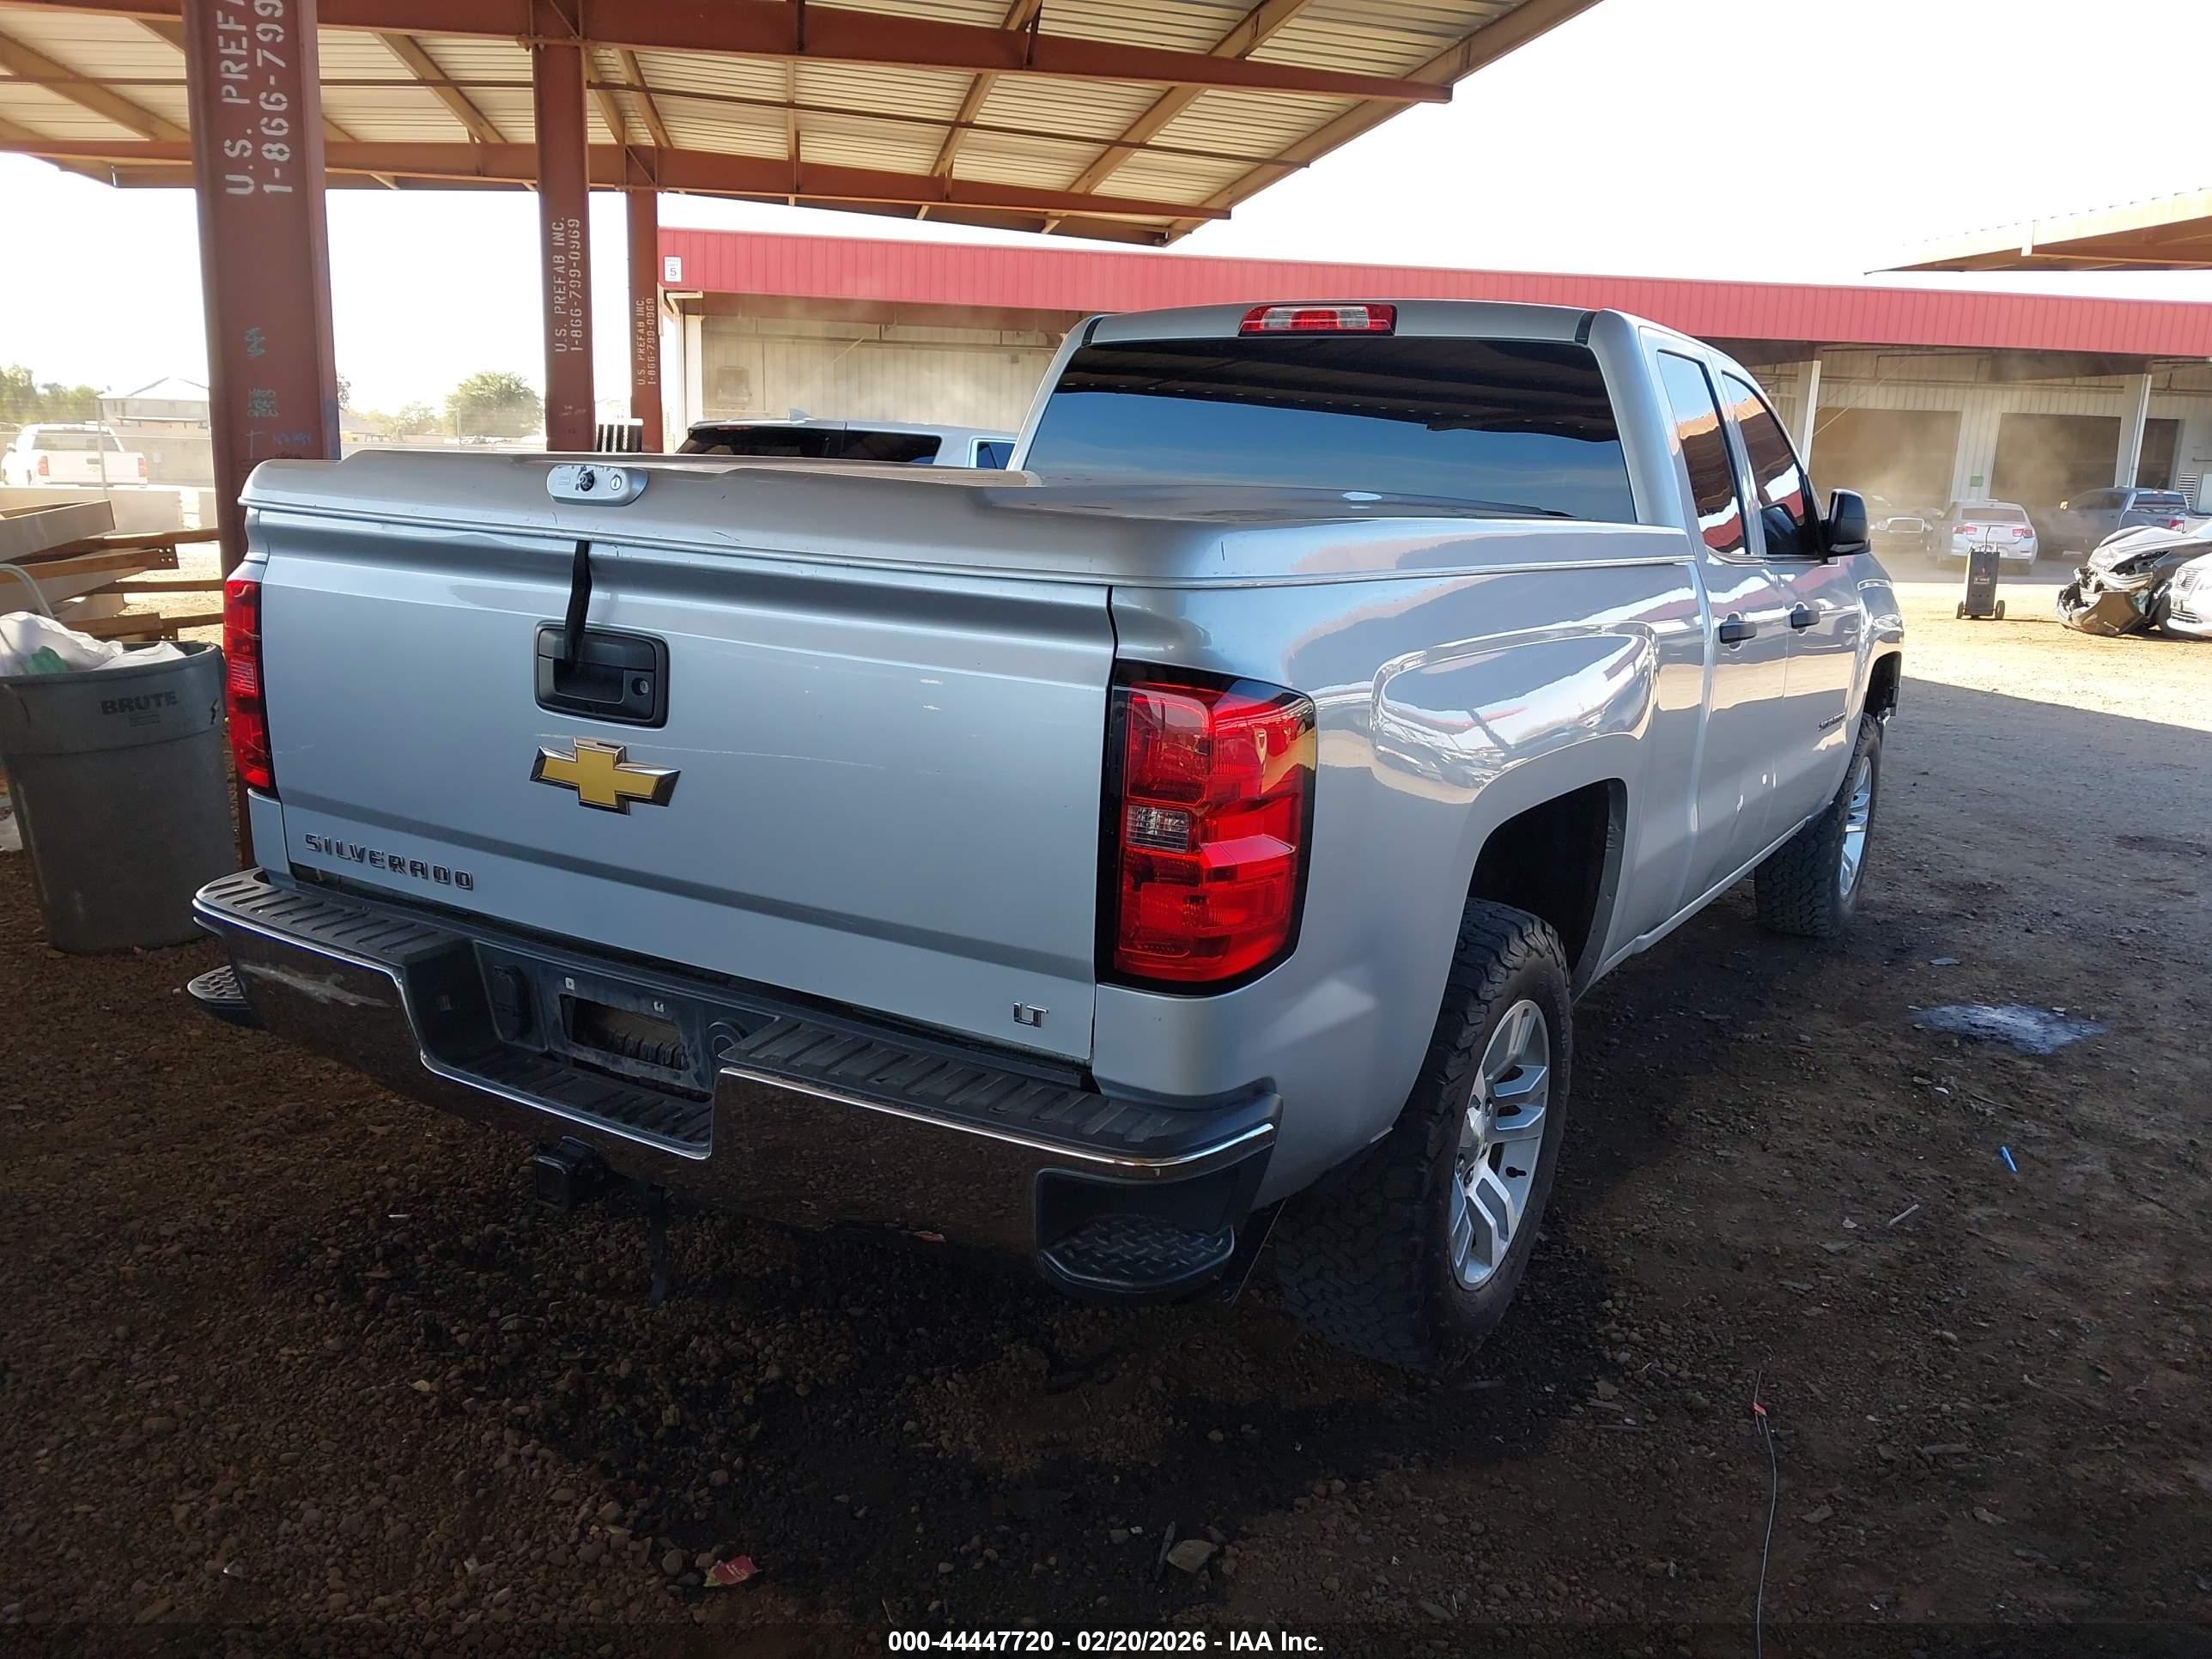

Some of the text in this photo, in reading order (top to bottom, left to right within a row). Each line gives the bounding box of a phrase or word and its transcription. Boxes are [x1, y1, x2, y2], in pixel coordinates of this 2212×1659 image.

[224, 128, 255, 195] U.S.
[551, 216, 568, 353] U.S. PREFAB INC.
[568, 218, 584, 351] 1-866-799-0969
[670, 267, 678, 276] 5
[635, 296, 645, 317] INC.
[636, 321, 646, 362] PREFAB
[100, 690, 179, 715] BRUTE
[305, 832, 474, 891] SILVERADO
[1013, 1002, 1048, 1029] LT
